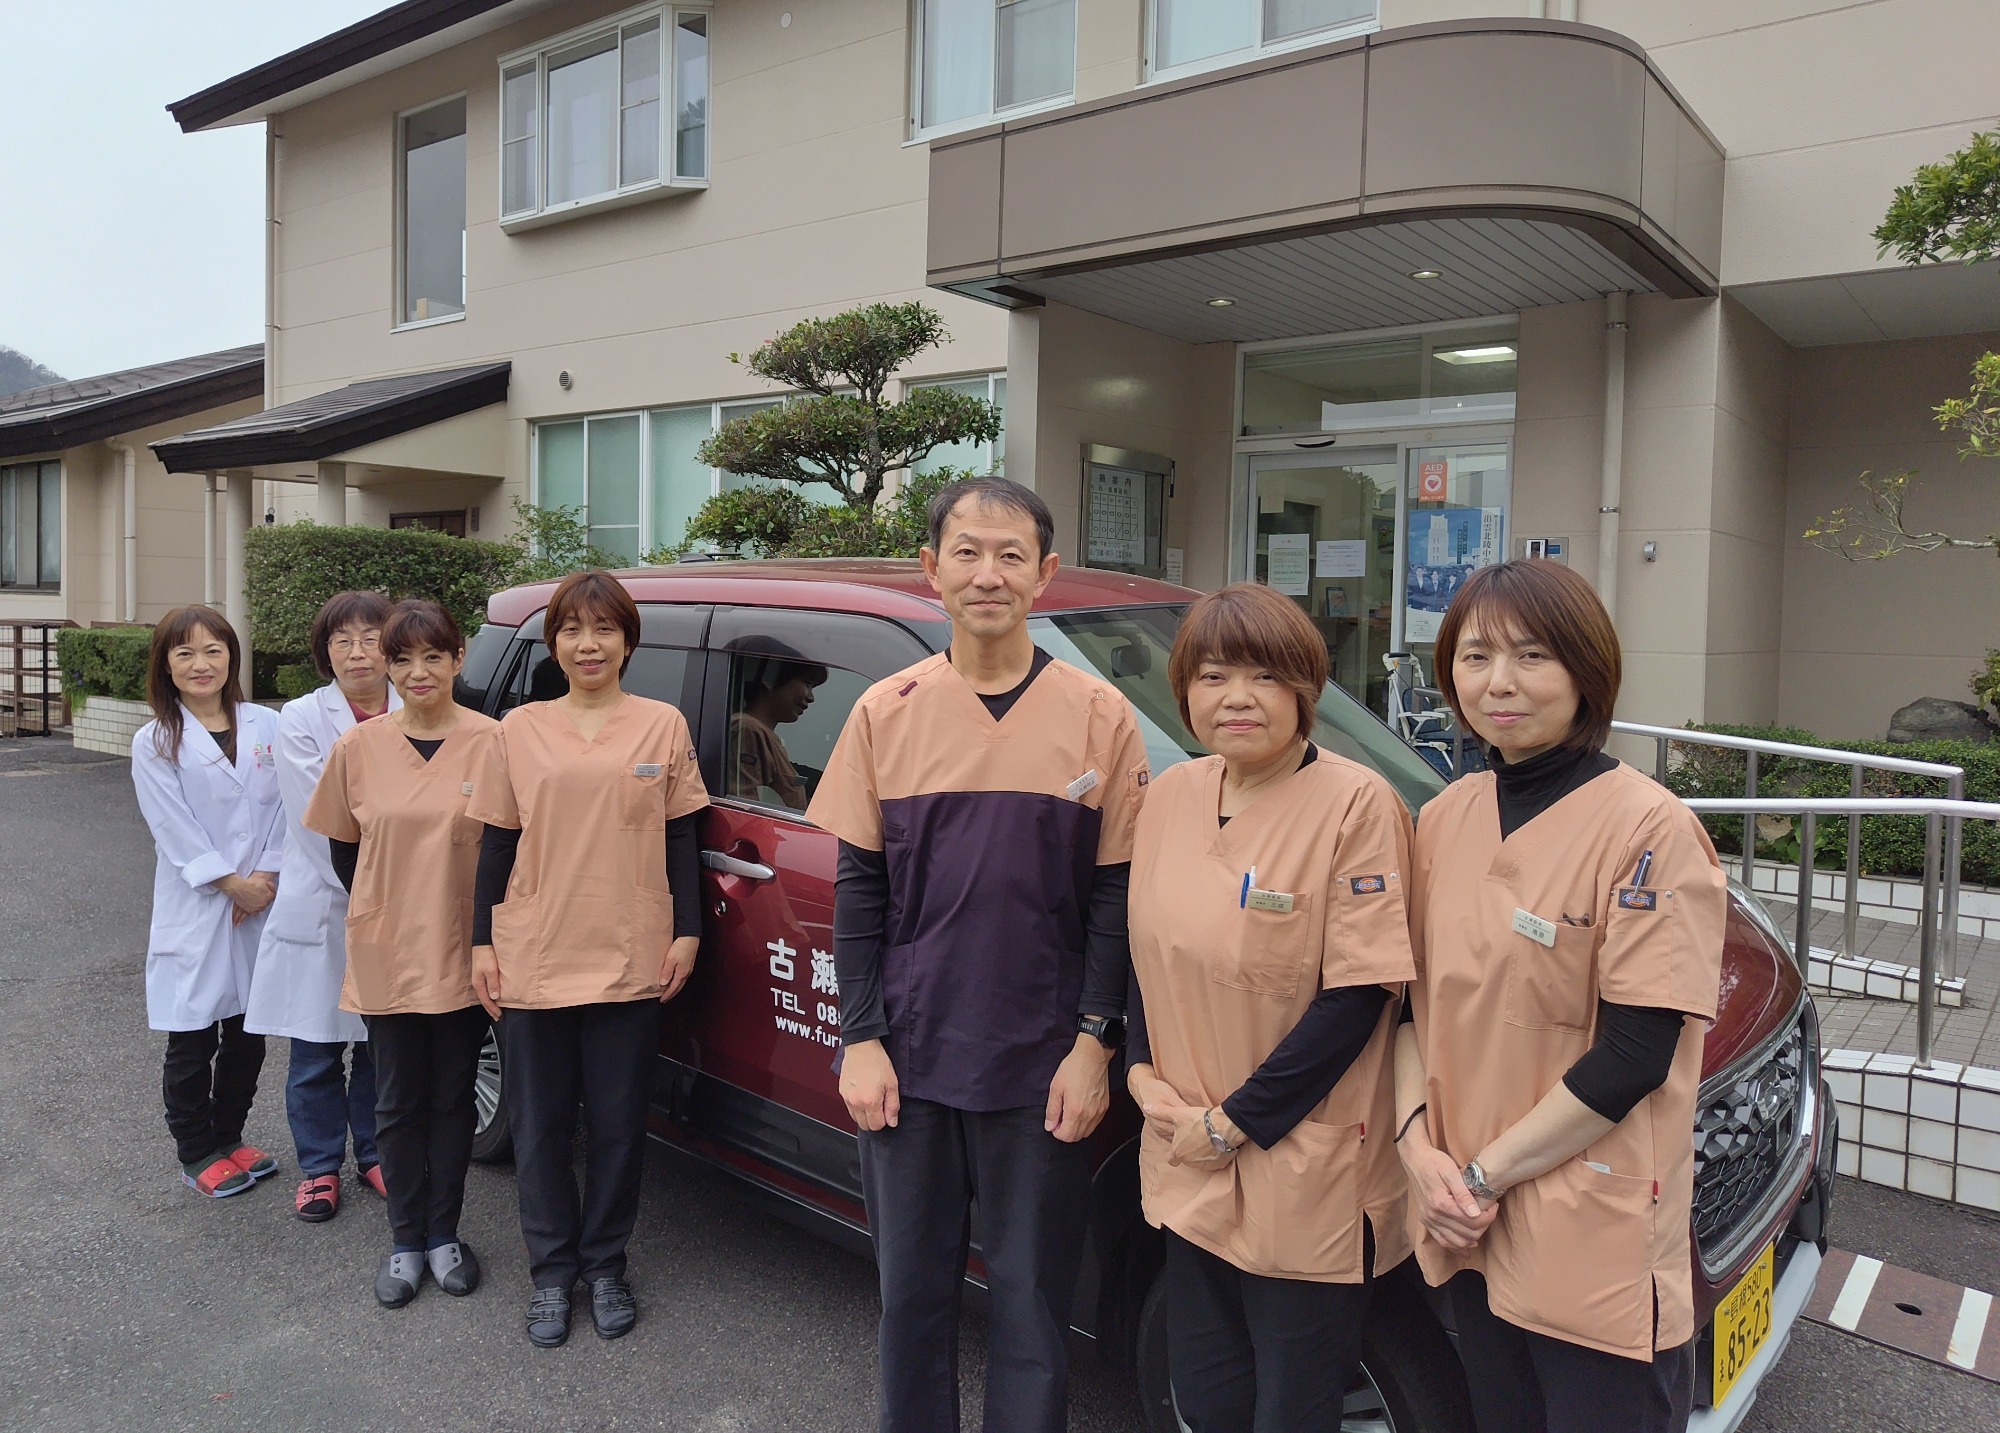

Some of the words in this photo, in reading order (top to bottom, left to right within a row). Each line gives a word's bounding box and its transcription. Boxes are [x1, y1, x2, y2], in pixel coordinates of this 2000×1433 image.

[1424, 463, 1443, 472] AED
[770, 987, 806, 1015] TEL
[816, 1001, 841, 1027] 08
[1727, 1286, 1770, 1382] 85-23
